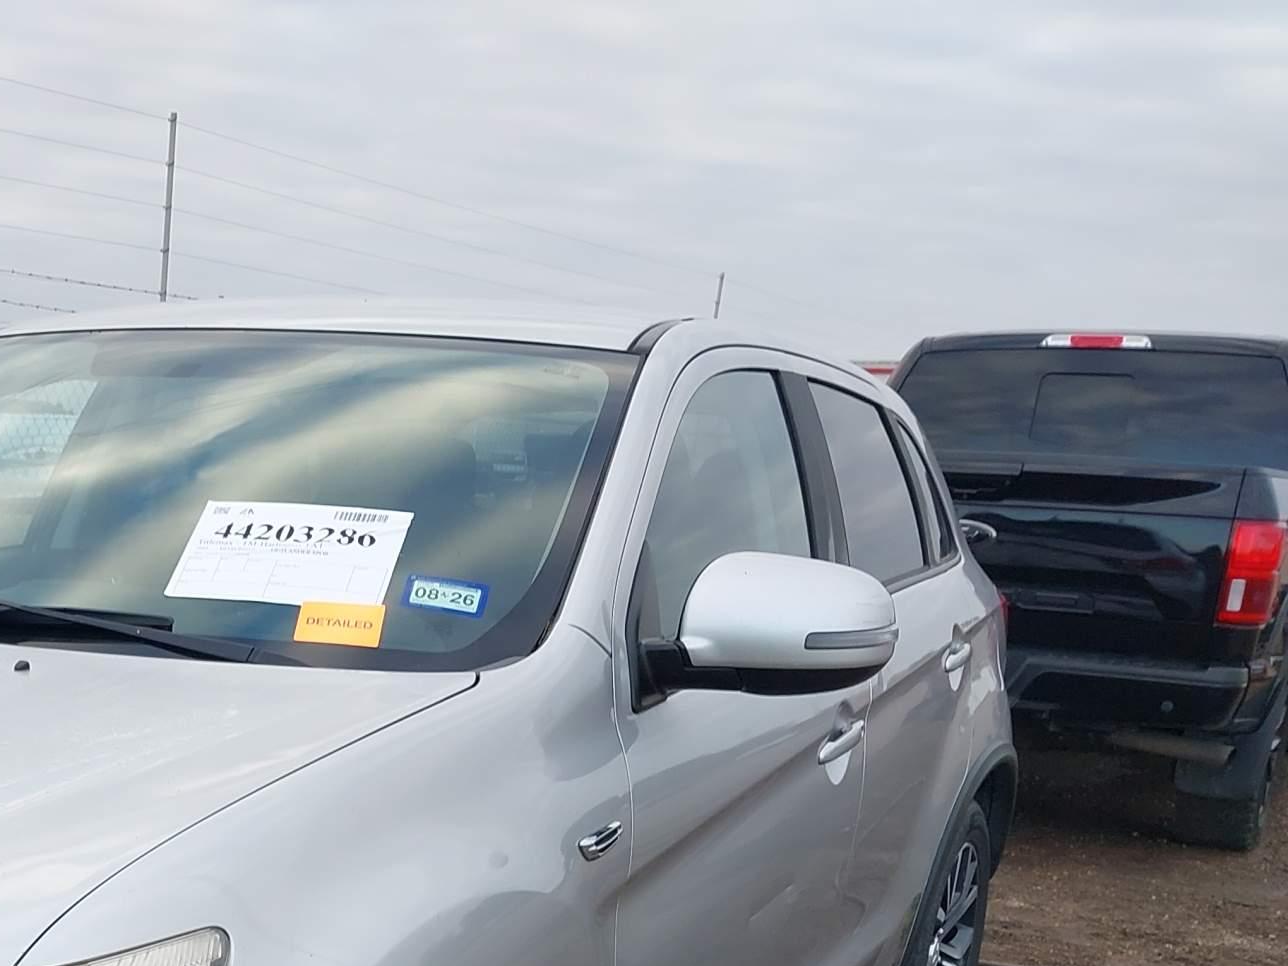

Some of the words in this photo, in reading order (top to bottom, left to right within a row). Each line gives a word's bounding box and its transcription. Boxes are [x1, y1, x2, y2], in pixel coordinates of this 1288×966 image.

[214, 522, 376, 548] 44203286
[414, 586, 440, 601] 08
[449, 591, 475, 607] 26
[305, 616, 374, 630] DETAILED
